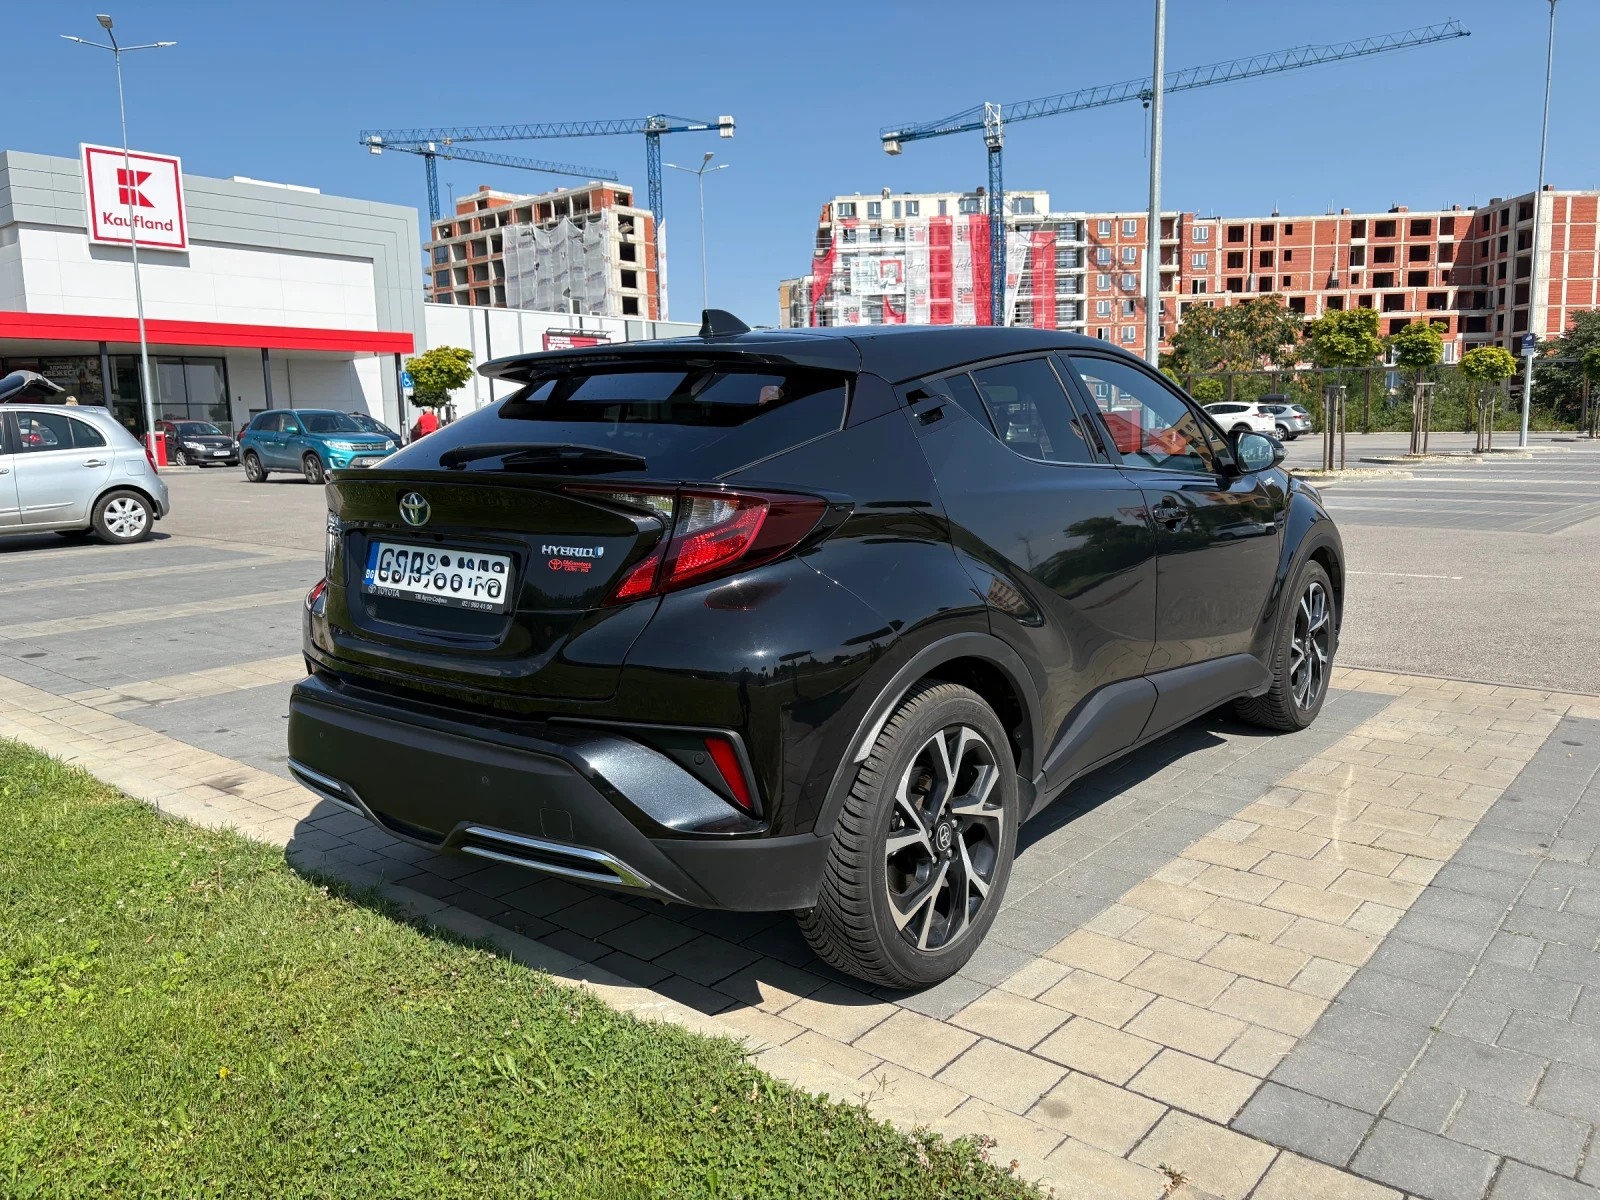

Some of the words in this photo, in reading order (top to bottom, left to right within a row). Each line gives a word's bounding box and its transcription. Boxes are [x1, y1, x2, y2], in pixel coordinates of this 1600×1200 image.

[103, 212, 173, 231] Kaufland
[542, 545, 593, 557] HYBRID
[366, 569, 374, 579] BG
[378, 586, 400, 597] TOYOTA
